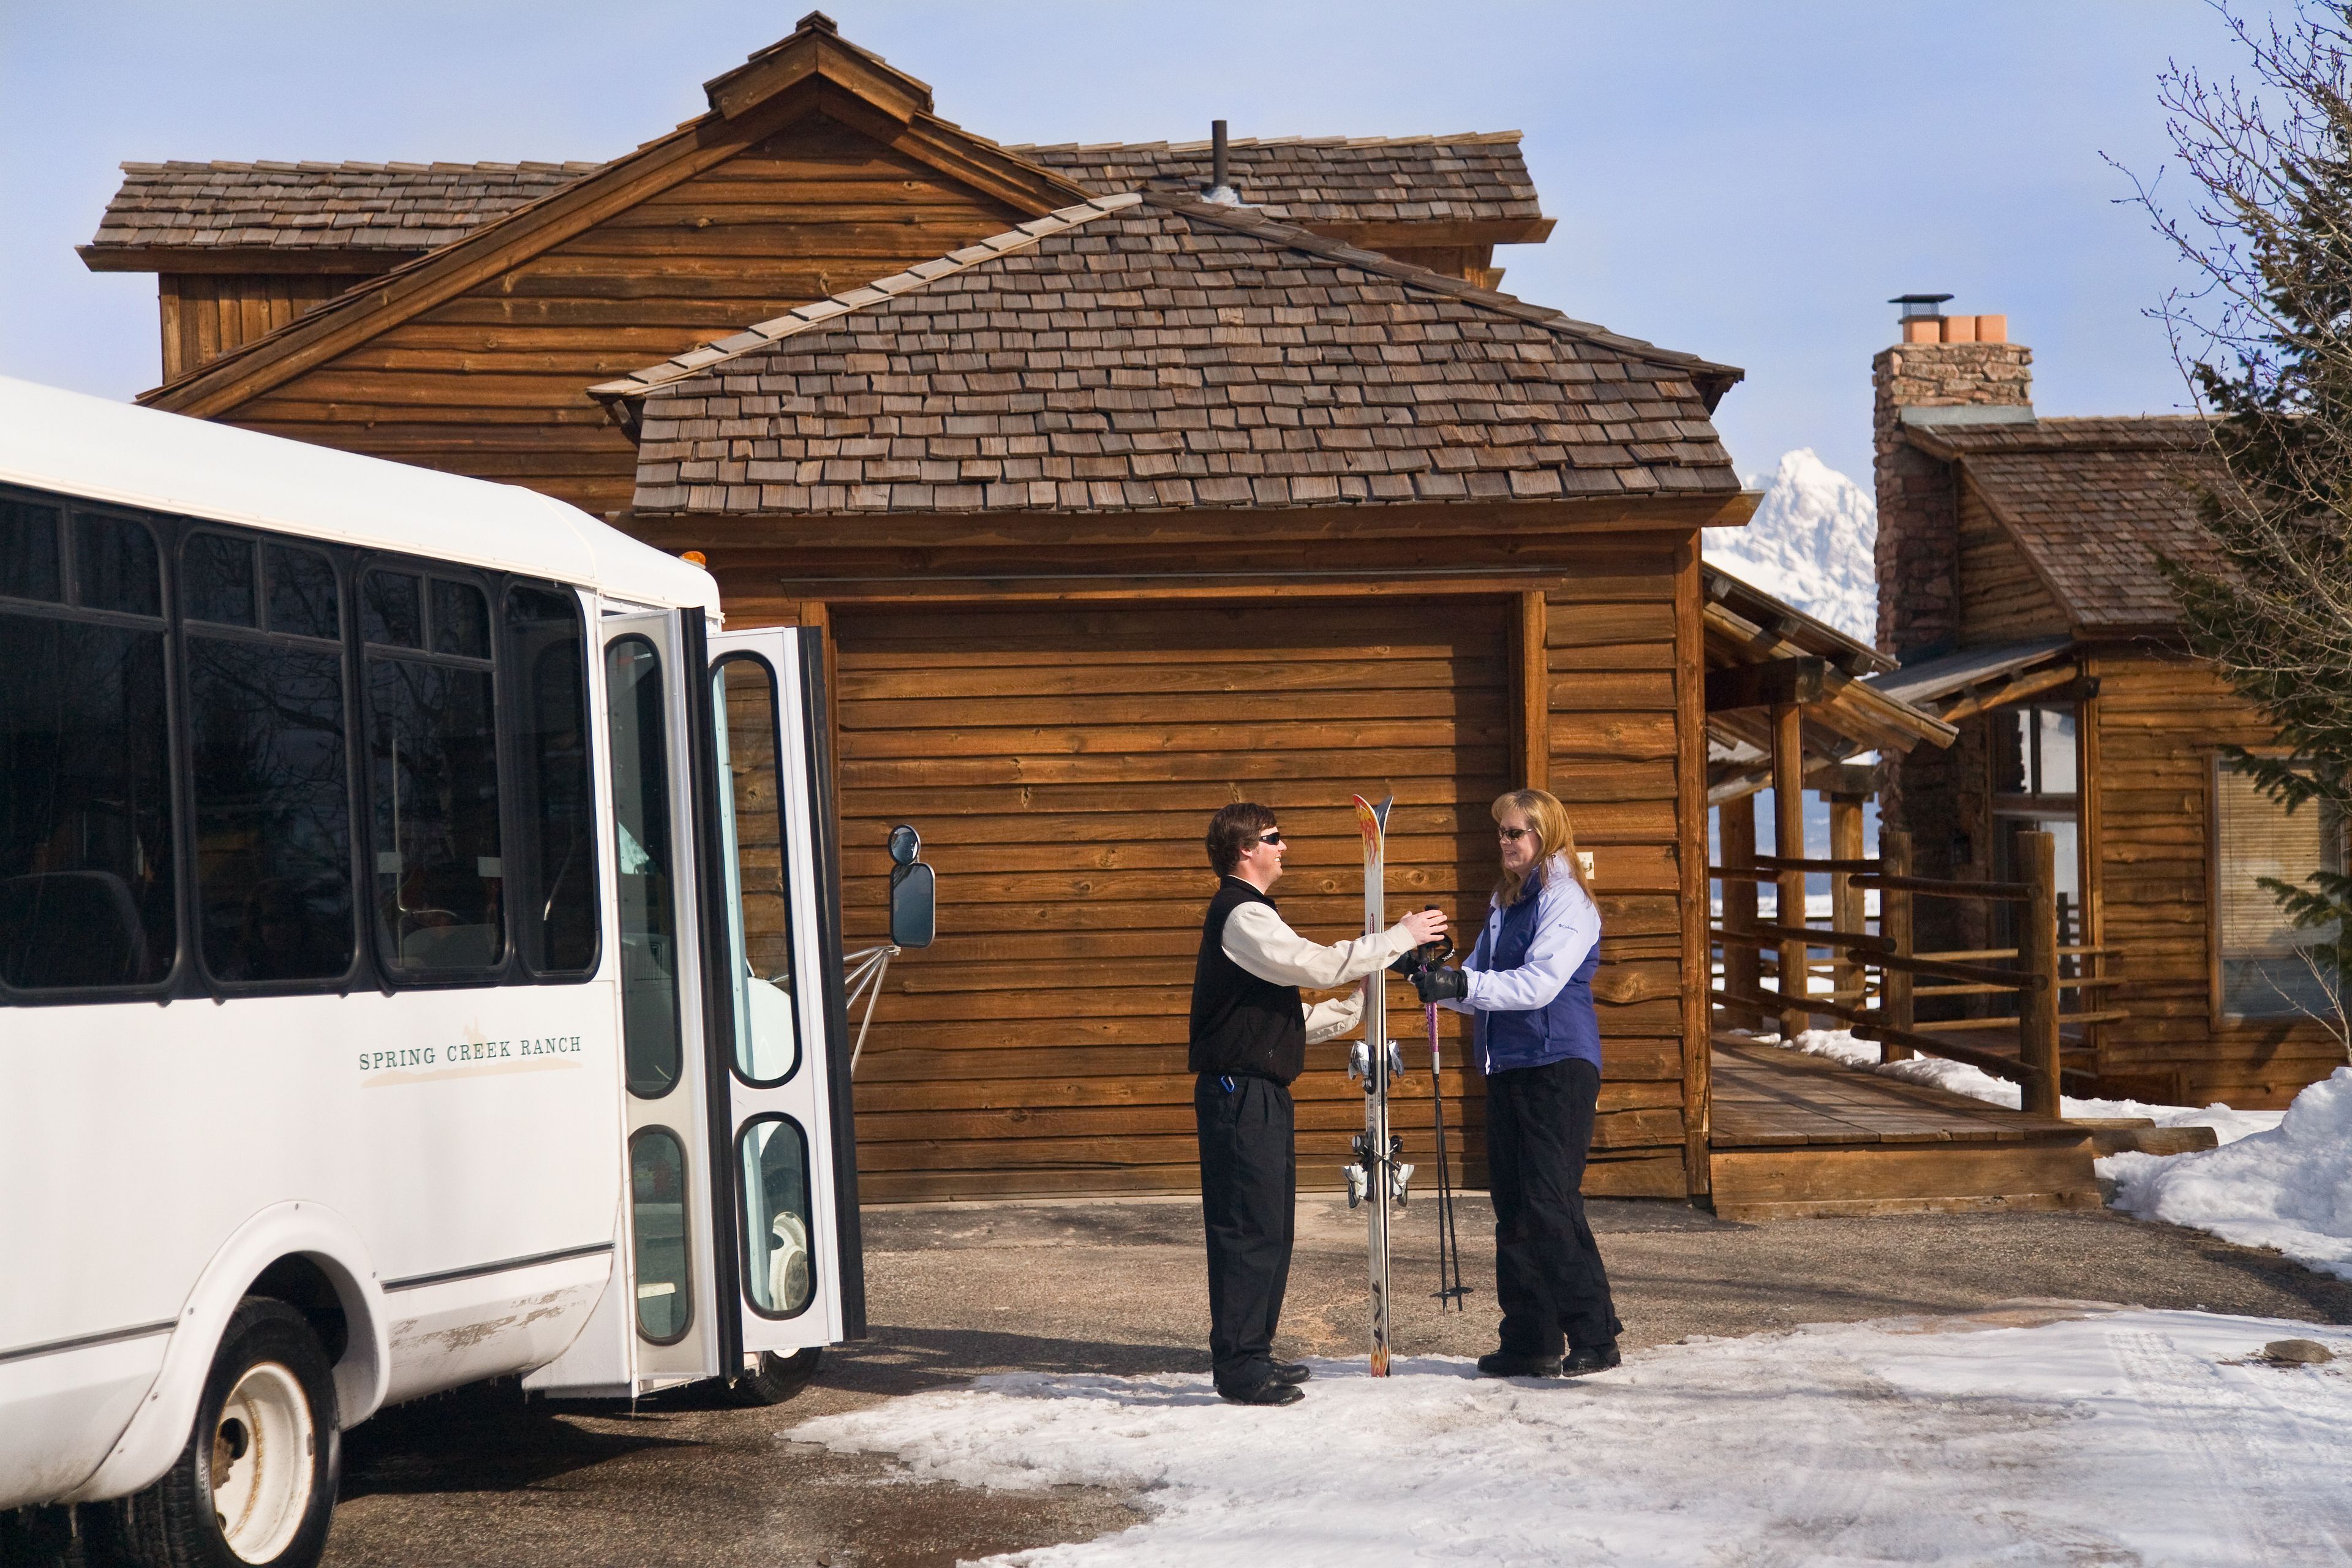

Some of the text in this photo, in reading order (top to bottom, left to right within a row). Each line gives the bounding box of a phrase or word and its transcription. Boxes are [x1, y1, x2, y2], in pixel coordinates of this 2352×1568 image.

[359, 1036, 582, 1071] SPRING CREEK RANCH
